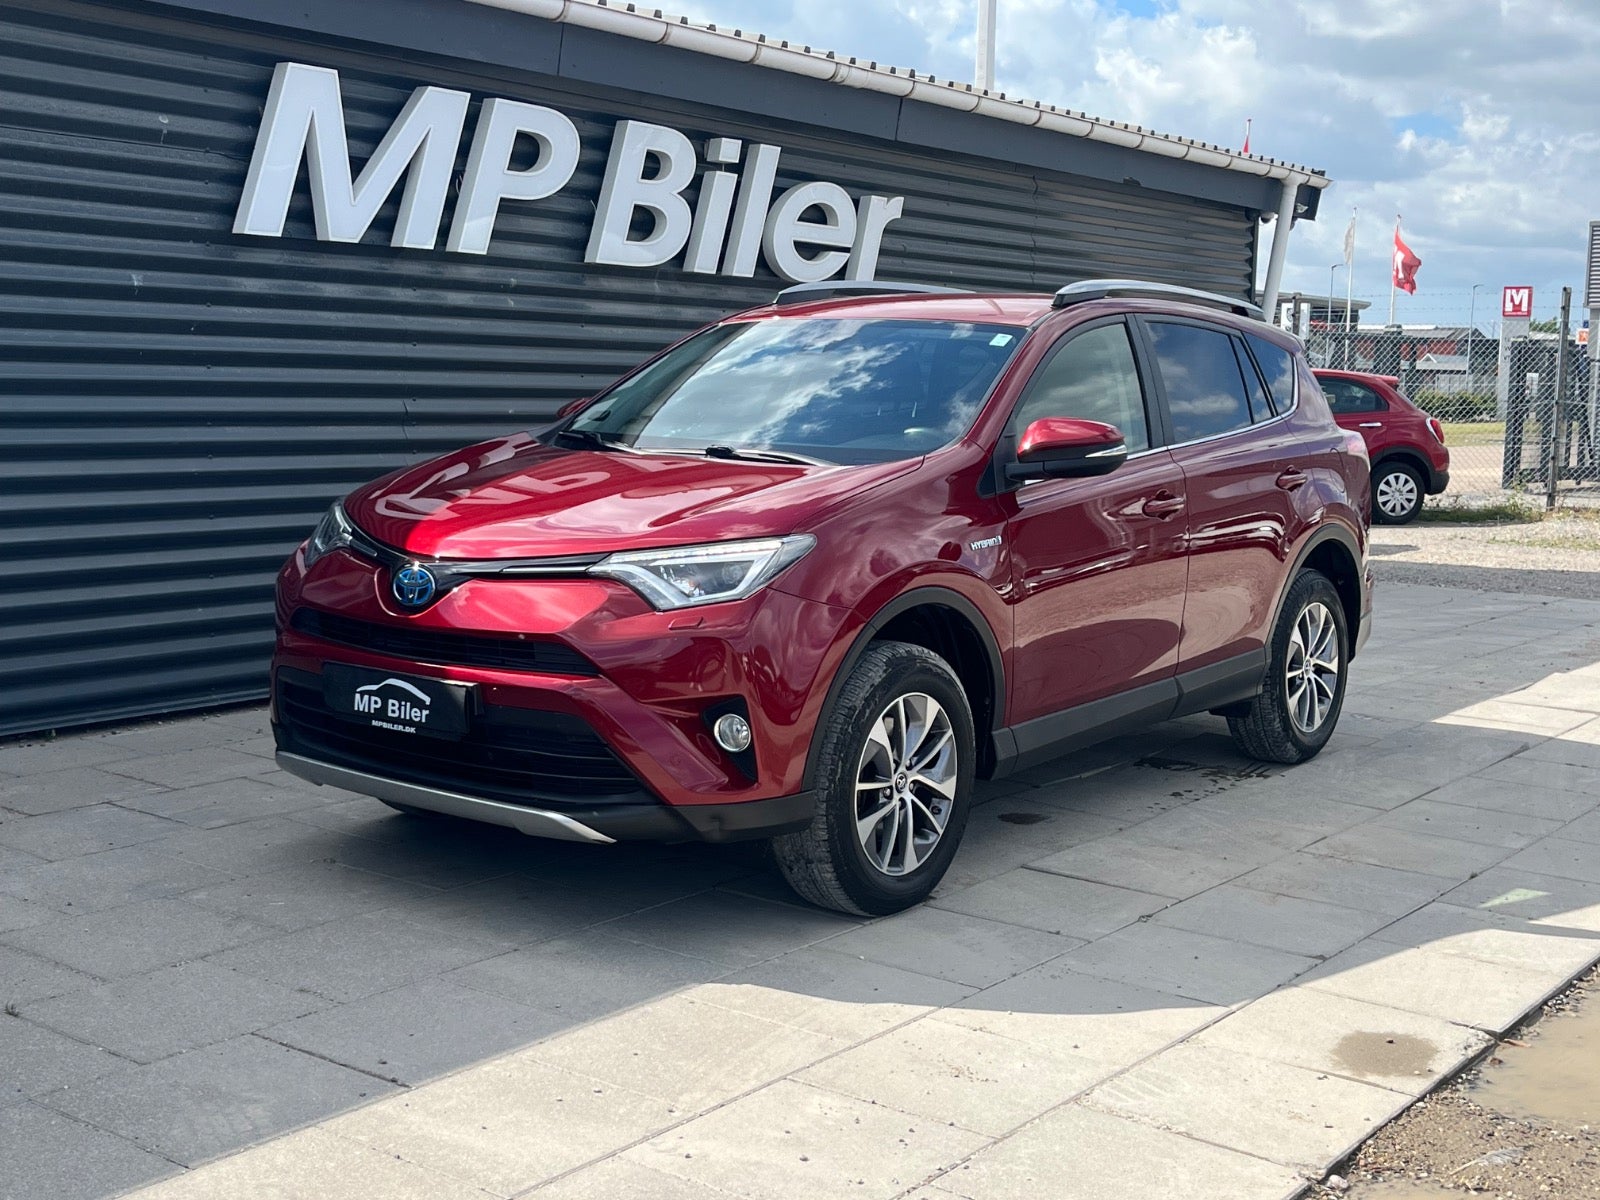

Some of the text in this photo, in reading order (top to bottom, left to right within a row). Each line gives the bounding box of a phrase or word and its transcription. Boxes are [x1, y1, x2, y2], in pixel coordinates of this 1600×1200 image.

[232, 62, 904, 283] MP Biler
[970, 537, 998, 550] HYBRID
[354, 693, 430, 723] MP Biler
[371, 720, 416, 733] MPBILER.DK
